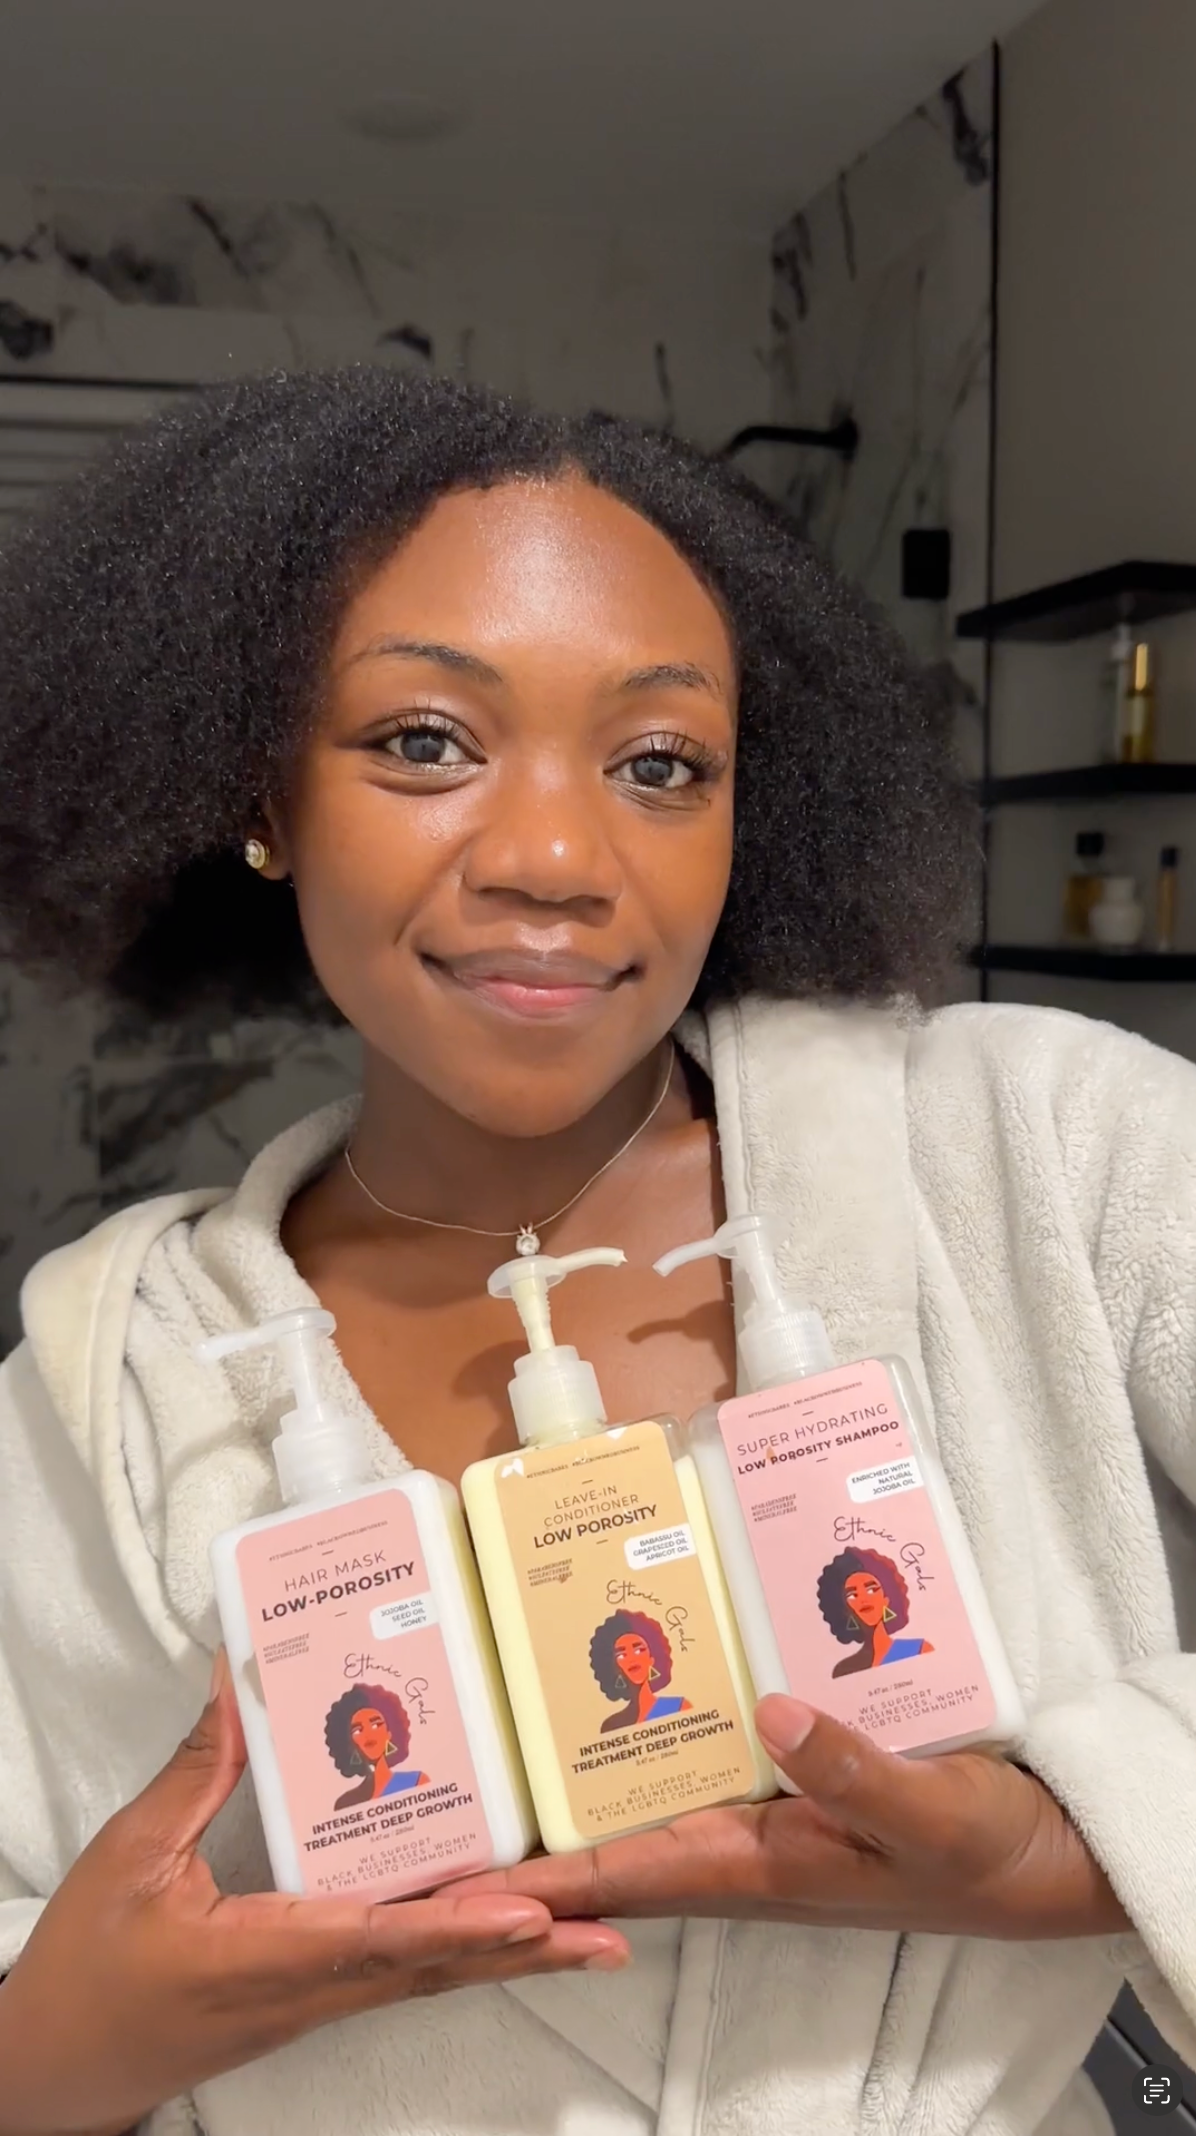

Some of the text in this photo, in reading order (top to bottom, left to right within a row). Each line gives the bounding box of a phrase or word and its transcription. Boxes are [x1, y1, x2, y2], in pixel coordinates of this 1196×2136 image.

[737, 1403, 888, 1456] SUPER HYDRATING
[738, 1421, 899, 1474] LOW POROSITY SHAMPOO
[852, 1462, 910, 1484] ENRICHED WITH
[873, 1478, 915, 1495] JOJOBA OIL
[878, 1470, 913, 1485] NATURAL
[544, 1495, 638, 1528] CONDITIONER
[555, 1485, 617, 1510] LEAVE-IN
[534, 1505, 657, 1548] LOW POROSITY
[639, 1530, 684, 1547] BABASSU OIL
[633, 1538, 687, 1556] GRAPESEED OIL
[646, 1545, 689, 1561] APRICOT OIL
[834, 1516, 935, 1591] Ethnic Gals
[285, 1550, 386, 1592] HAIR MASK
[262, 1561, 414, 1622] LOW-POROSITY
[381, 1603, 409, 1617] JOJOBA
[392, 1608, 425, 1622] SEED OIL
[401, 1616, 427, 1628] HONEY
[606, 1579, 696, 1652] Ethnic Gals
[344, 1653, 436, 1724] Ethnic Gals
[859, 1689, 933, 1715] WE SUPPORT
[936, 1685, 979, 1701] WOMEN
[865, 1715, 901, 1730] LGBTQ
[906, 1695, 974, 1719] COMMUNITY
[572, 1720, 734, 1773] TREATMENT DEEP GROWTH
[580, 1709, 719, 1757] INTENSE CONDITIONING
[588, 1802, 622, 1816] BLACK
[700, 1767, 740, 1784] WOMEN
[607, 1805, 627, 1819] THE
[632, 1796, 667, 1811] LGBTQ
[671, 1777, 735, 1800] COMMUNITY
[628, 1771, 698, 1795] WE SUPPORT
[304, 1793, 473, 1851] TREATMENT DEEP GROWTH
[312, 1783, 458, 1834] INTENSE CONDITIONING
[318, 1870, 352, 1886] BLACK
[434, 1833, 476, 1850] WOMEN
[338, 1873, 358, 1888] THE
[363, 1865, 399, 1880] LGBTQ
[404, 1843, 470, 1868] COMMUNITY
[359, 1838, 431, 1864] WE SUPPORT
